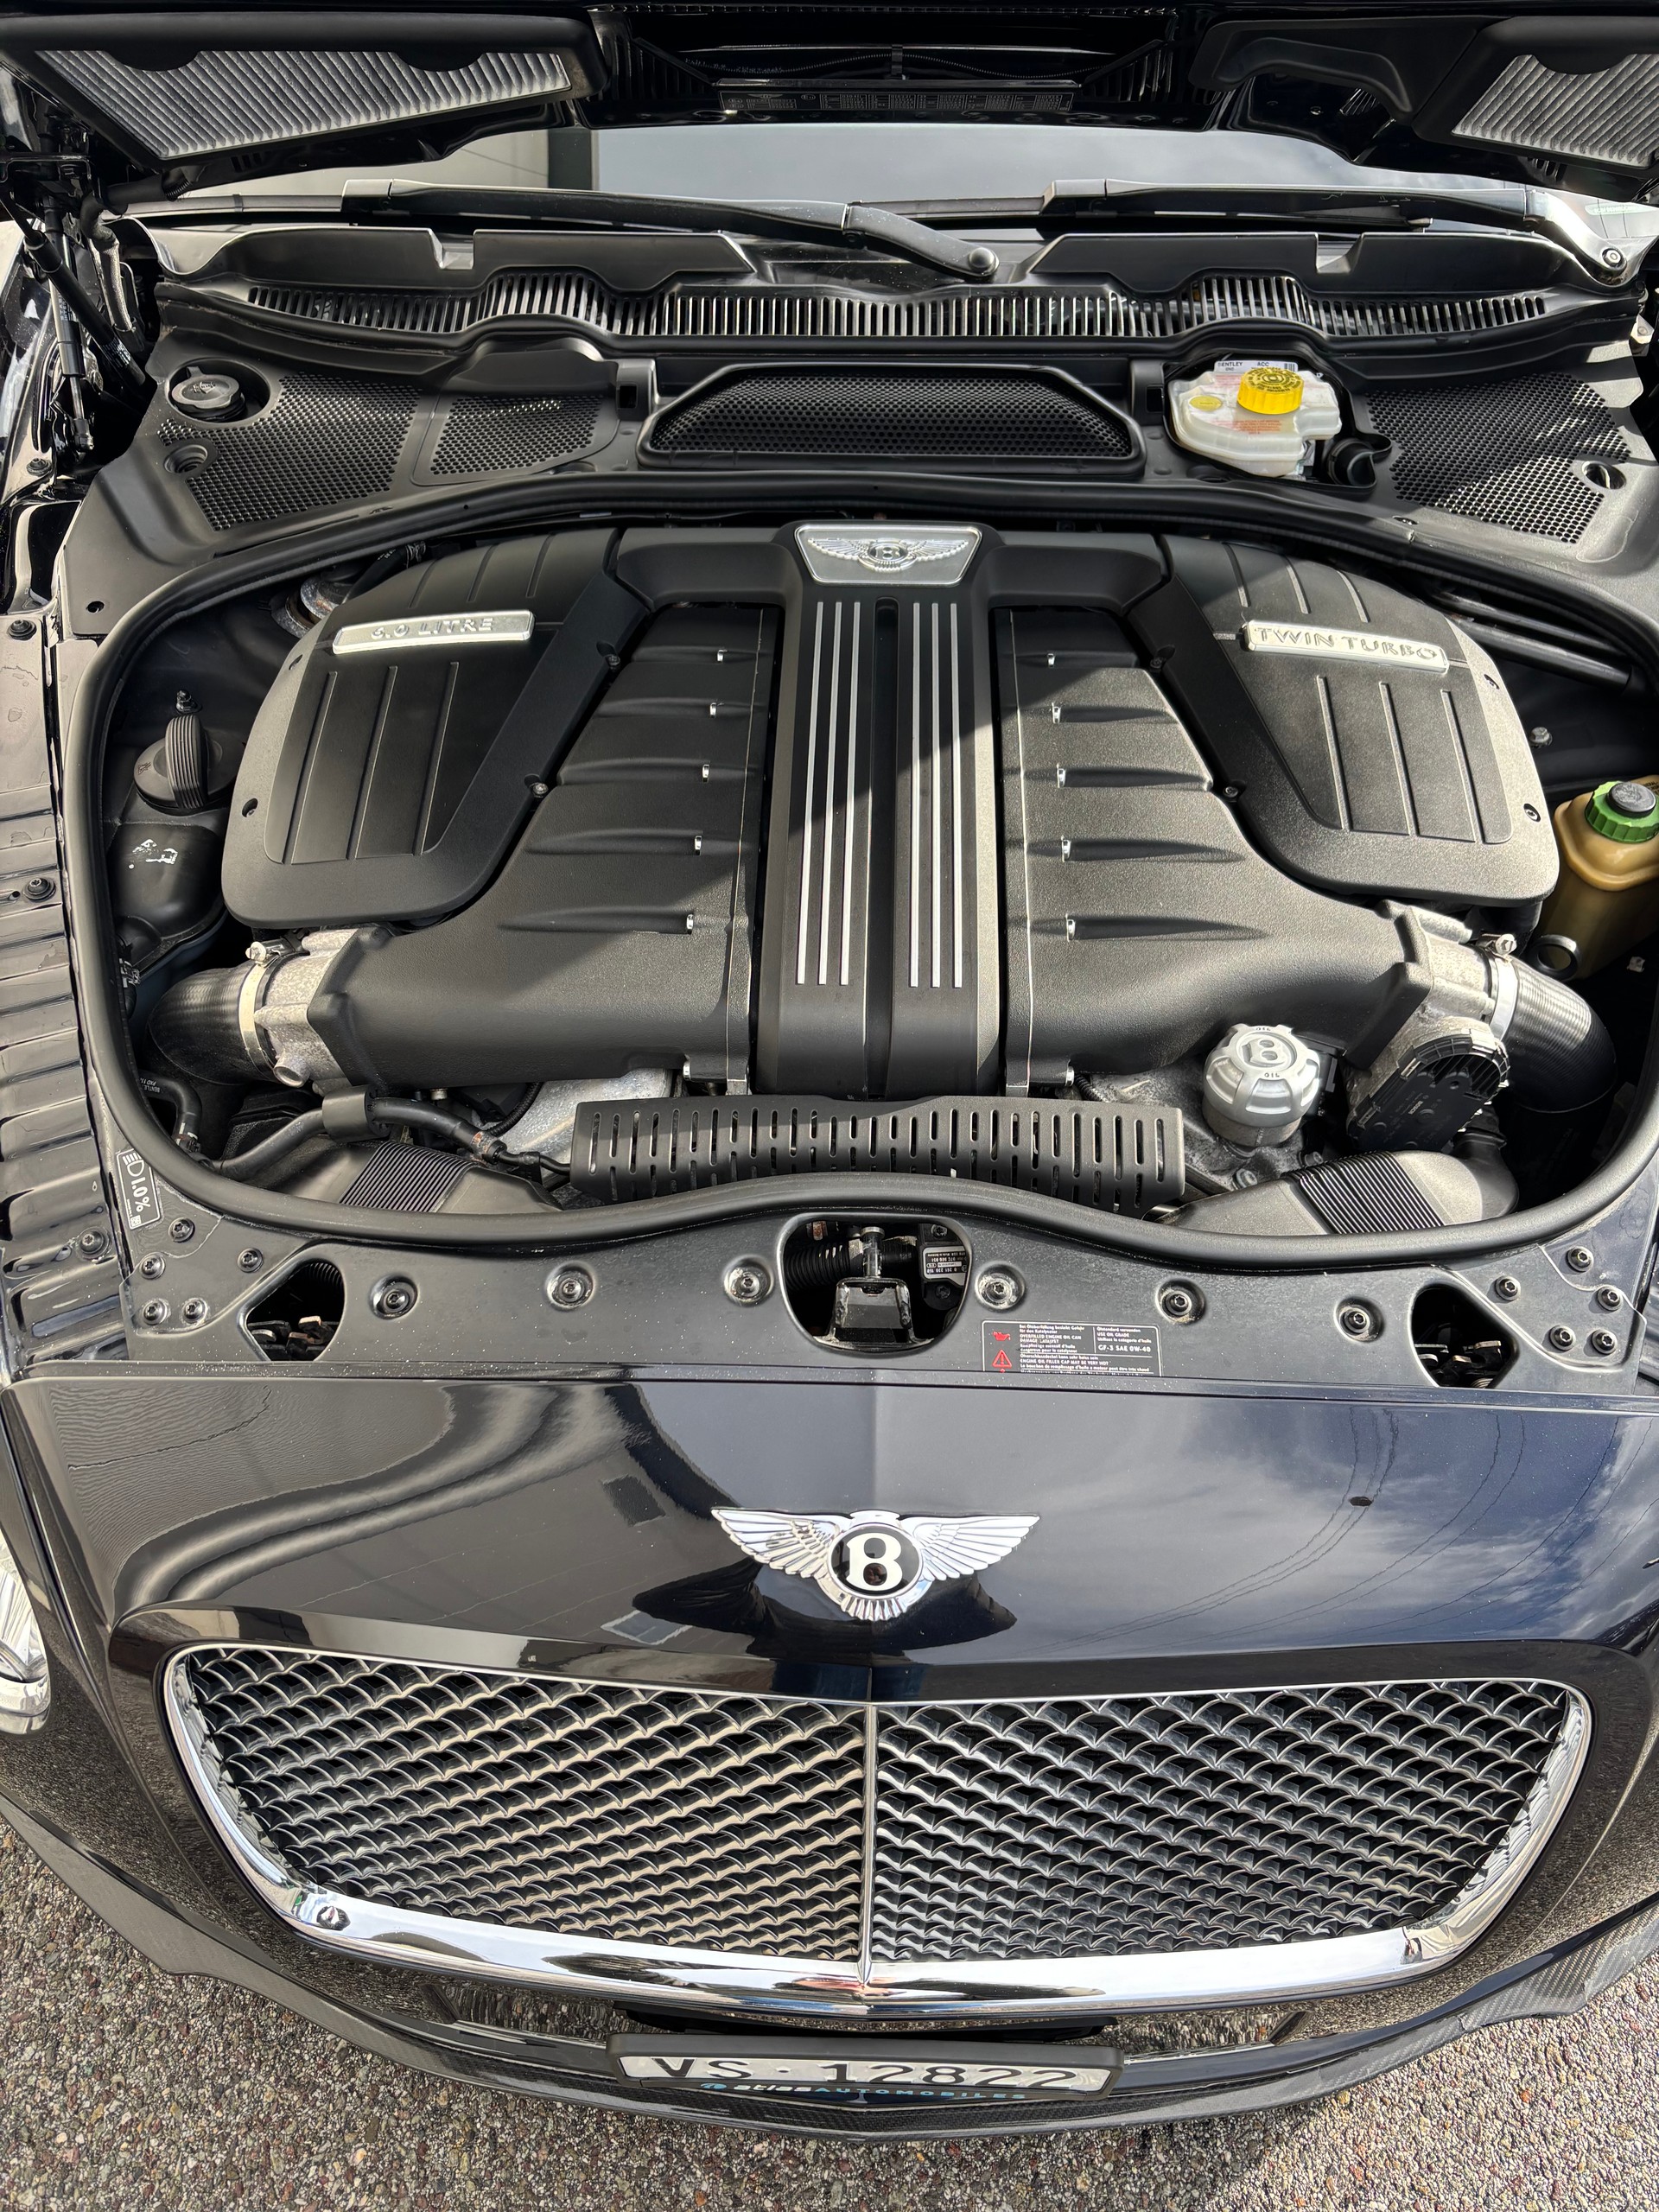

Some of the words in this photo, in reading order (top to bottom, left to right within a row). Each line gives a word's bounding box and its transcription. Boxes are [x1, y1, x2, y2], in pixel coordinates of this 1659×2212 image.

[371, 624, 410, 639] 6.0
[418, 617, 494, 635] LITRE
[1254, 626, 1336, 648] TWIN
[1340, 635, 1438, 660] TURBO
[130, 1177, 151, 1213] 1.0%
[652, 2057, 752, 2079] VS
[820, 2063, 1077, 2089] 12822
[814, 2087, 1026, 2100] AUTOMOBILES
